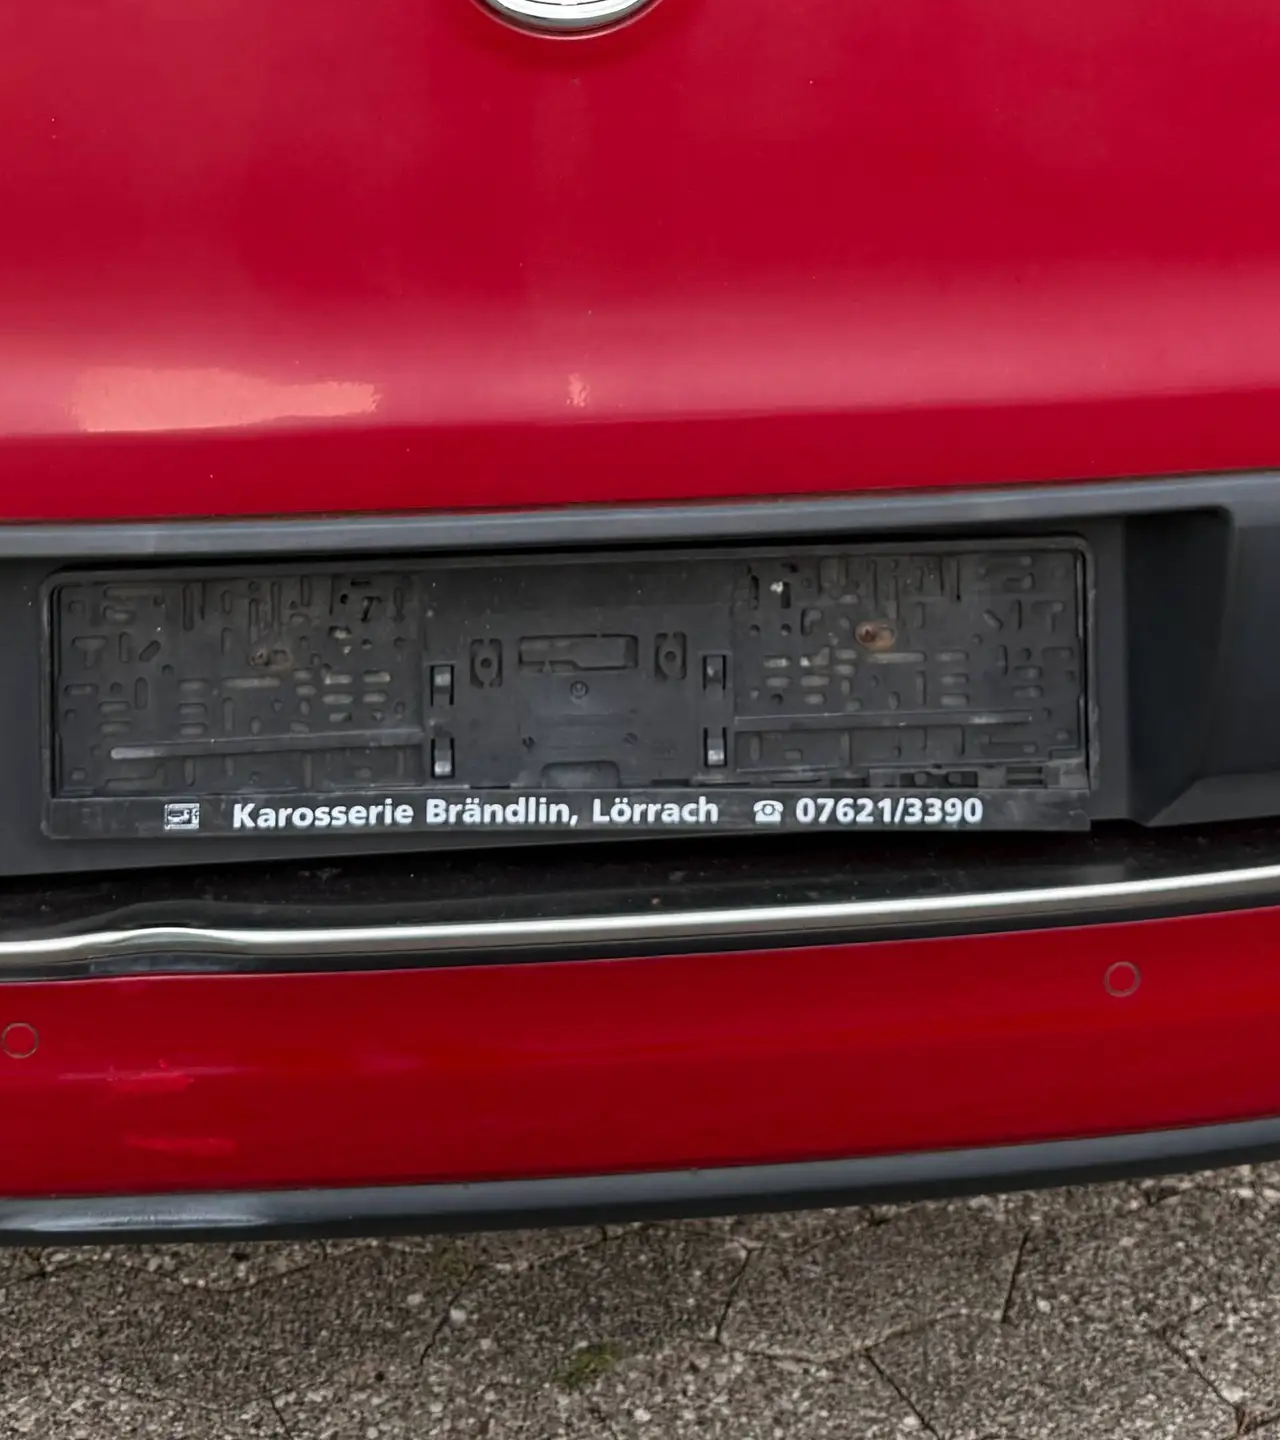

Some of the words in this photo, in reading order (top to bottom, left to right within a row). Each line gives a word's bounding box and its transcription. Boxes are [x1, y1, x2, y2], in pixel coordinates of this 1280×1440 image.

[232, 798, 414, 828] Karosserie
[425, 797, 579, 827] Brändlin,
[592, 796, 719, 824] Lörrach
[795, 797, 984, 824] 07621/3390
